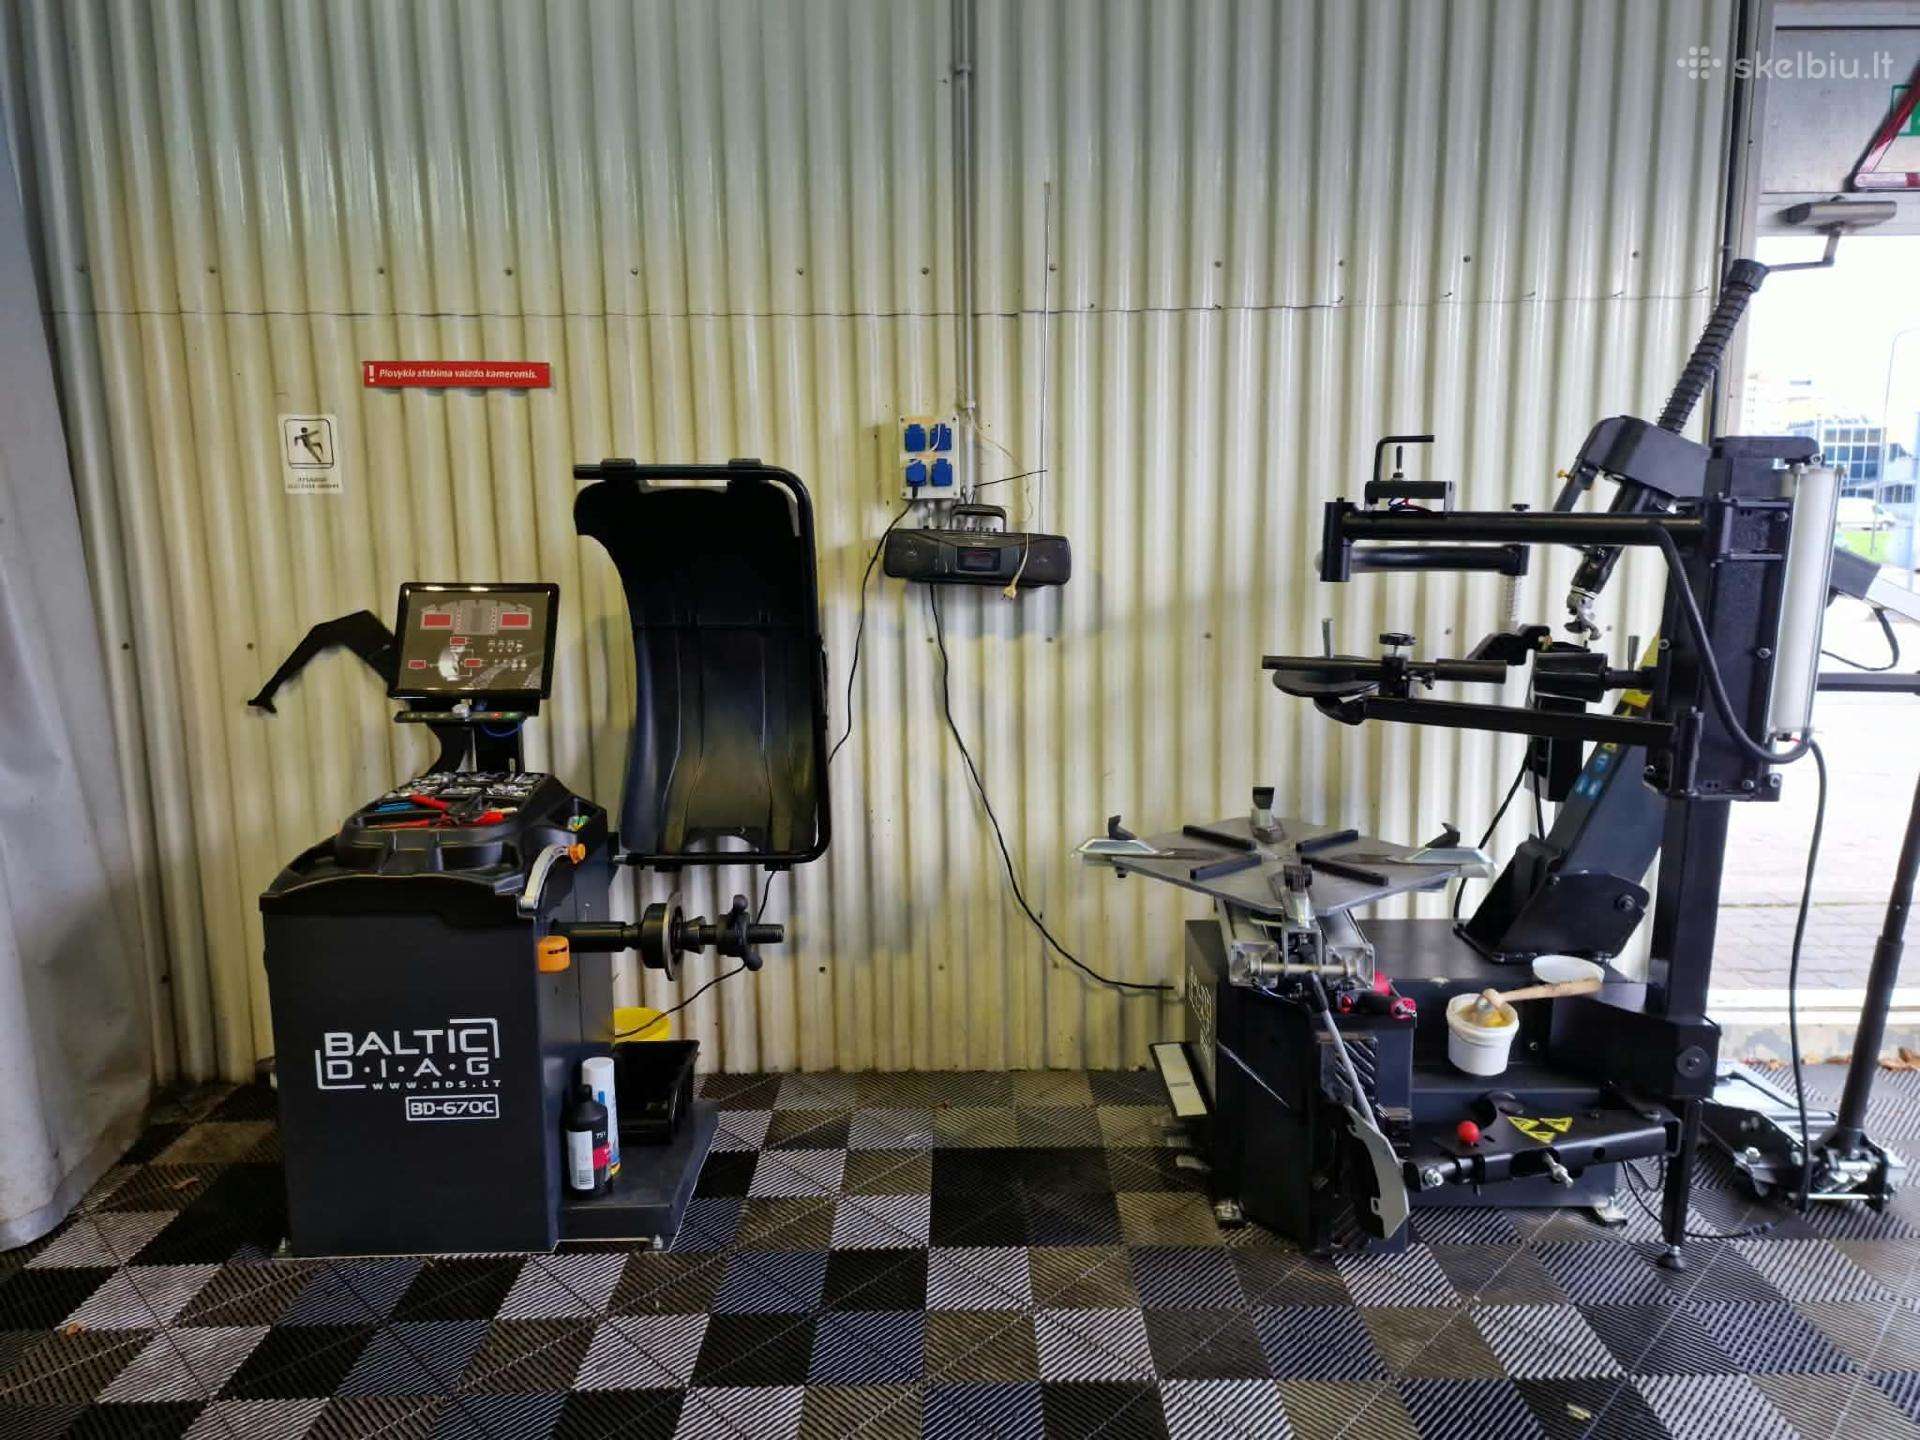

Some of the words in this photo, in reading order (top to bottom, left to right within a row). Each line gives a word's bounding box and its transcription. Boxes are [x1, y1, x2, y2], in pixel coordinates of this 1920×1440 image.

[455, 369, 485, 379] vaizdo
[486, 370, 537, 380] kameromis.
[324, 1029, 488, 1057] BALTIC
[411, 1101, 495, 1116] BD-670C
